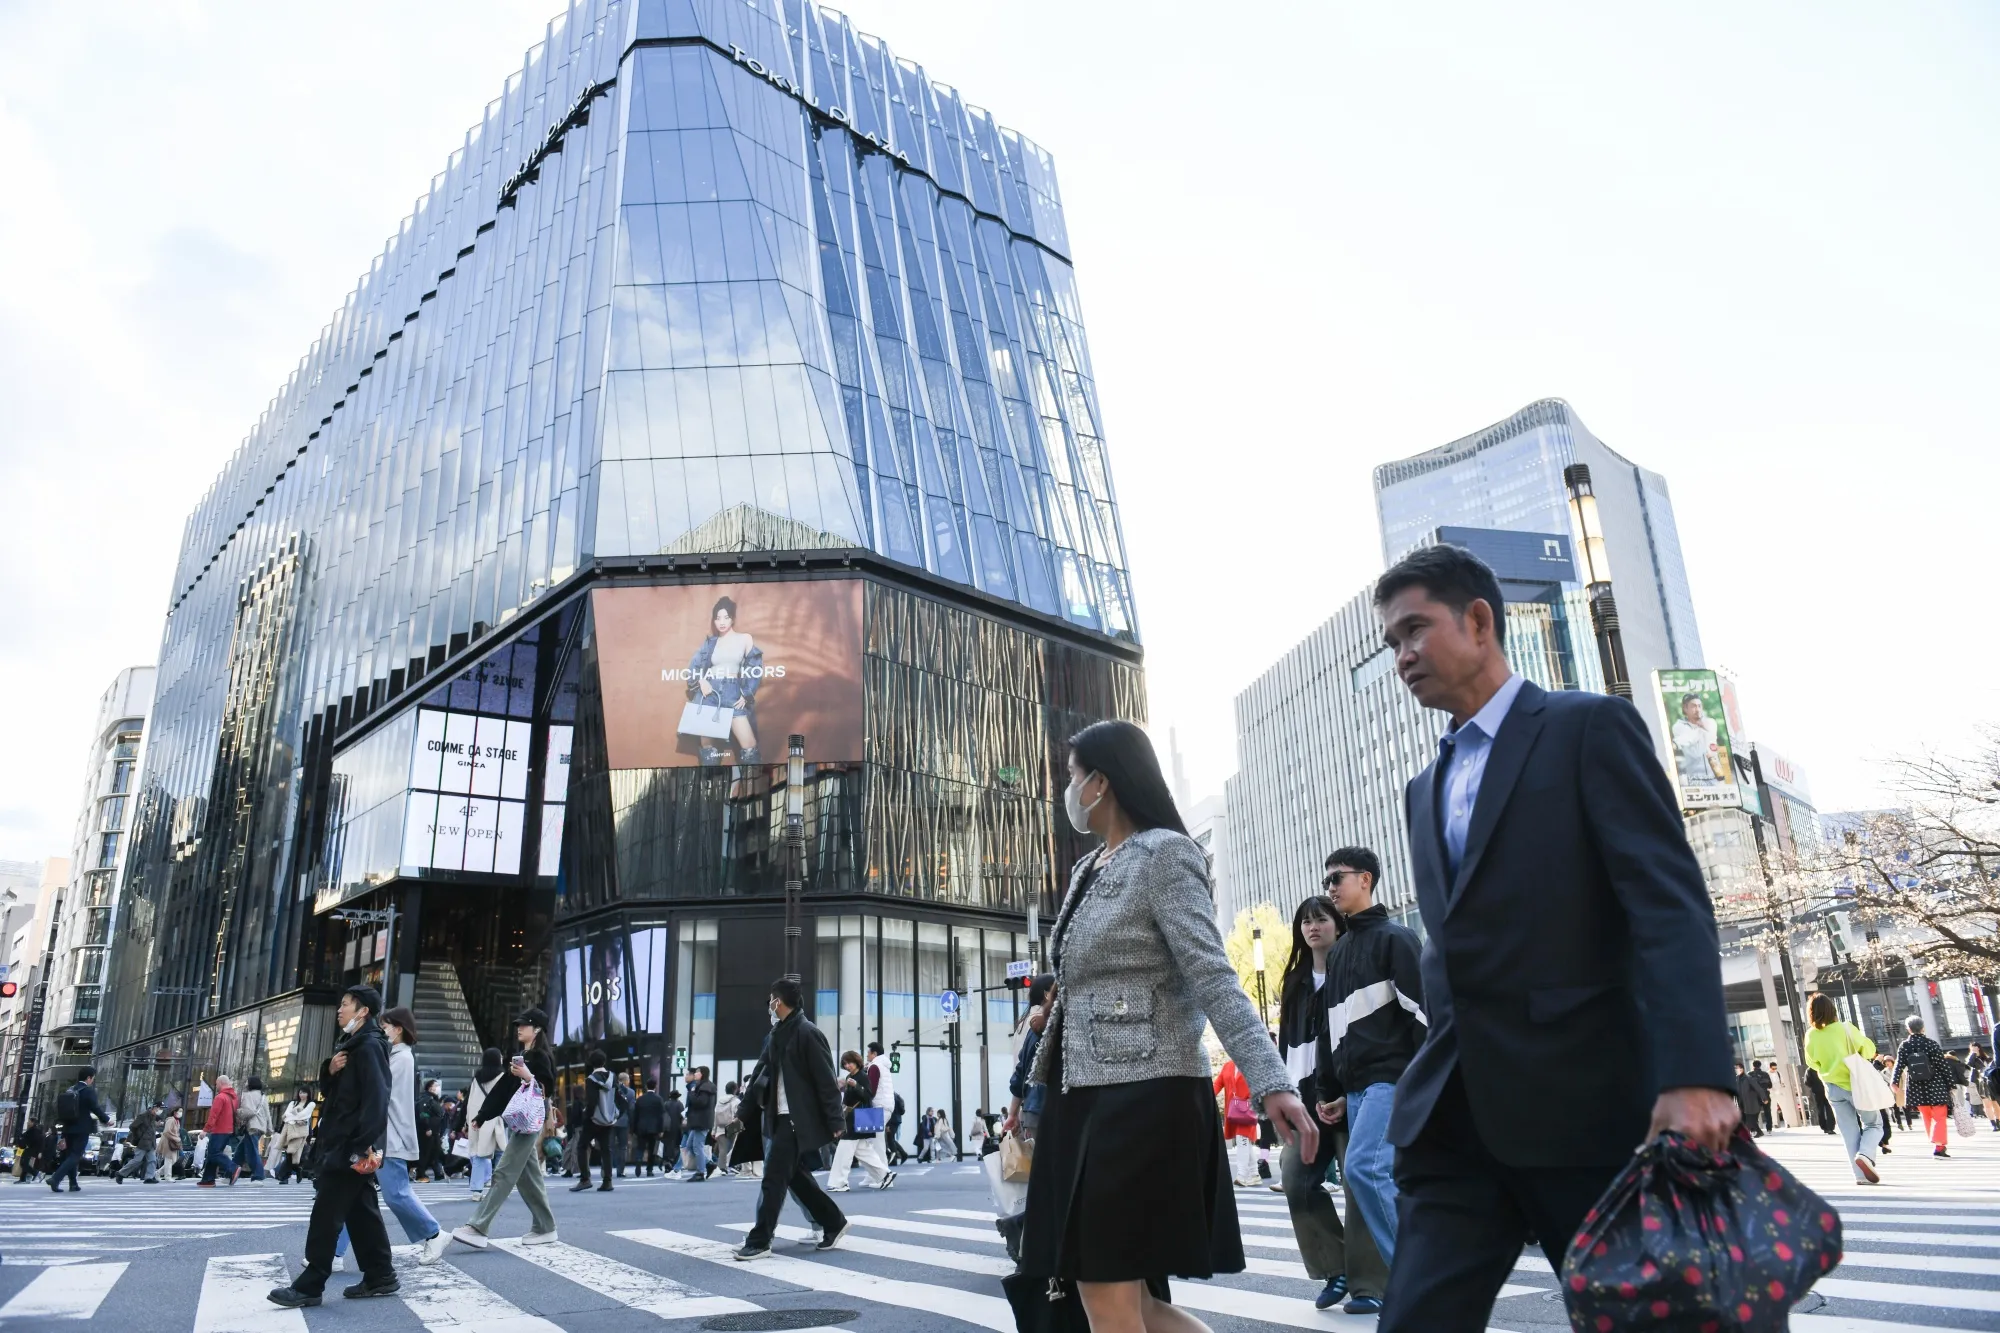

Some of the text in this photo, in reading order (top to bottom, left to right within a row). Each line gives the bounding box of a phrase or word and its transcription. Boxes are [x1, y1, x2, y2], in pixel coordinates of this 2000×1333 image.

[729, 43, 819, 107] TOKYU
[661, 665, 786, 681] MICHAEL KORS
[427, 740, 465, 755] COMME
[486, 747, 518, 761] STAGE
[457, 760, 486, 769] GINZA
[459, 806, 479, 817] 4F
[426, 824, 504, 840] NEW OPEN
